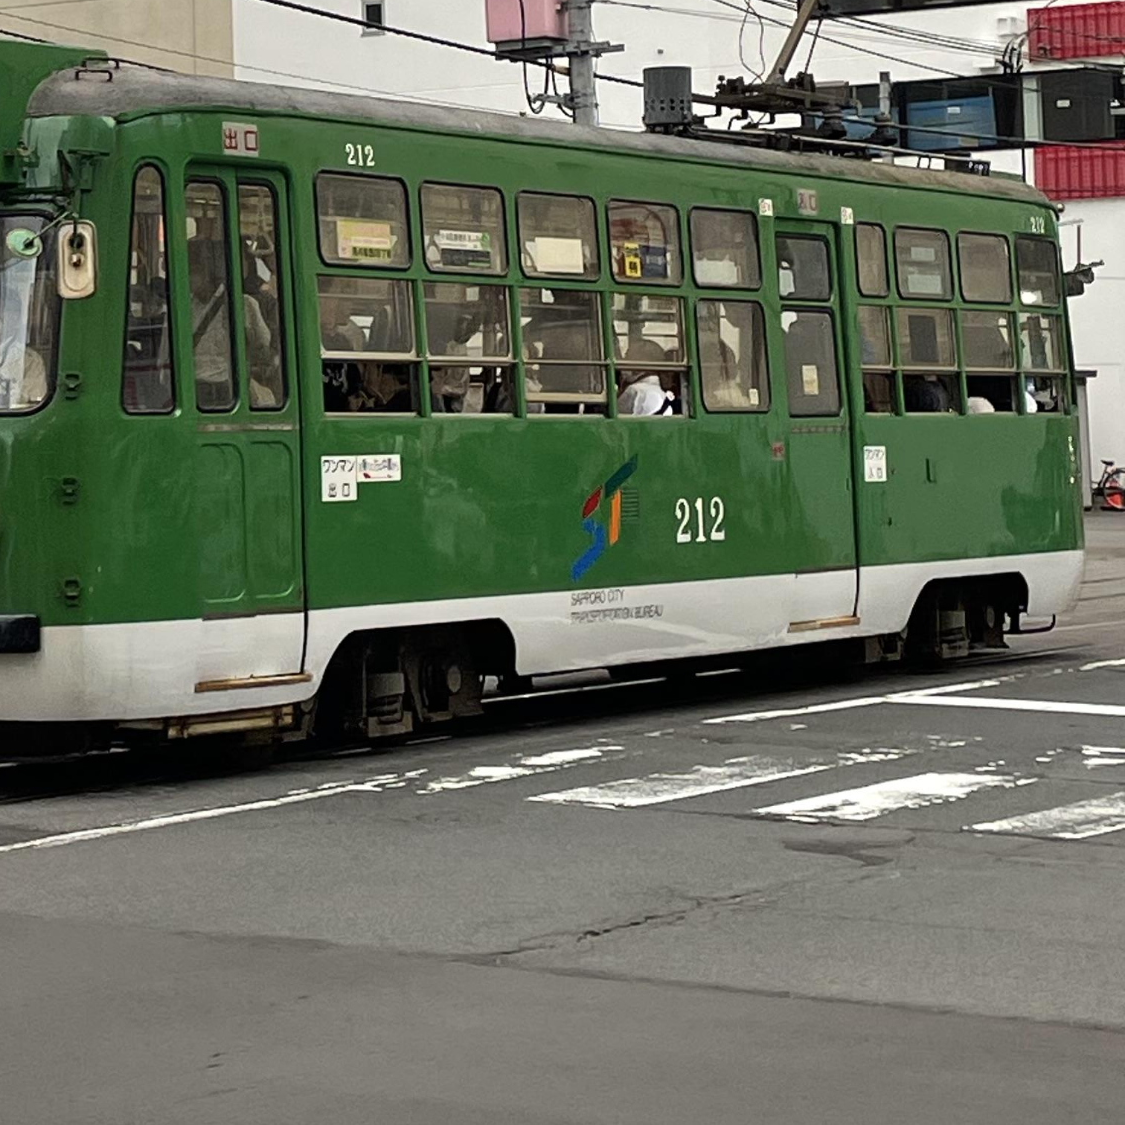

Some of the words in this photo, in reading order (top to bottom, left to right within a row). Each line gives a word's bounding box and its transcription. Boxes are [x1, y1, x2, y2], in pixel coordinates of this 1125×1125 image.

[224, 128, 258, 151] 出口
[345, 143, 375, 166] 212
[322, 459, 355, 473] ワンマン
[675, 496, 725, 543] 212
